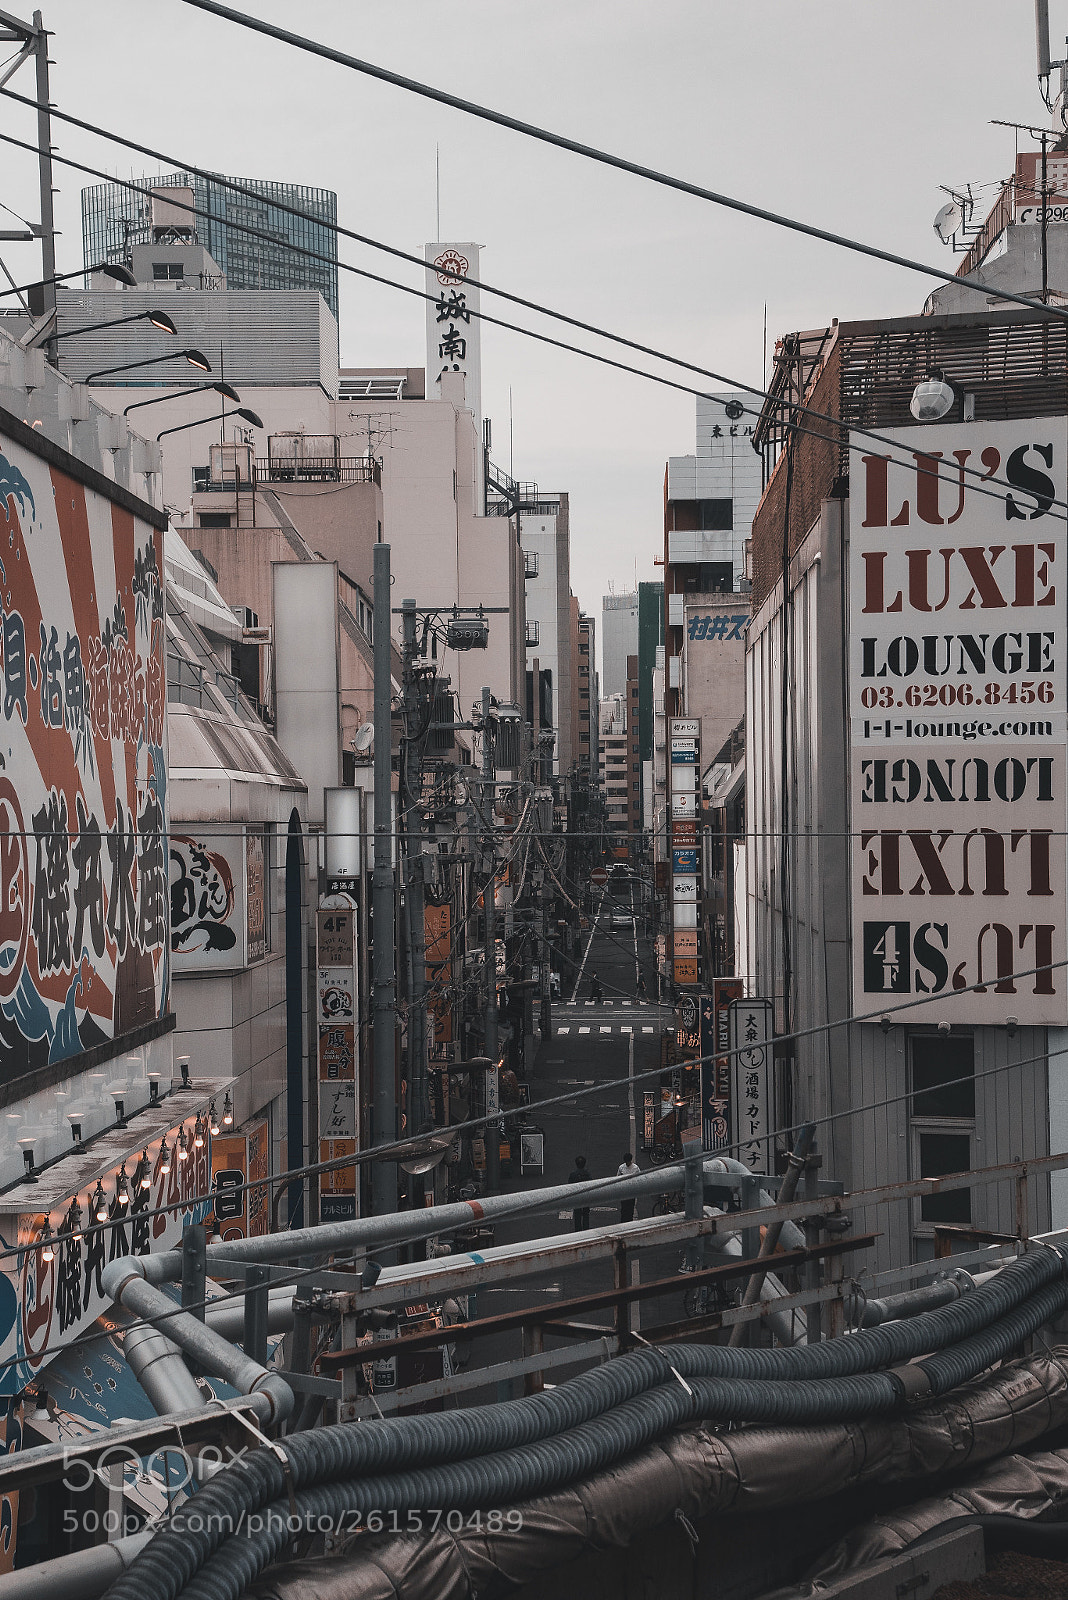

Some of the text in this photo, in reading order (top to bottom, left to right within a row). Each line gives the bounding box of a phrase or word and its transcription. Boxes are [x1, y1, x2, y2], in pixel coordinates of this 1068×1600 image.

[861, 443, 1056, 527] LU'S
[861, 543, 1056, 613] LUXE
[688, 615, 751, 640] 村井ス
[861, 632, 1055, 677] LOUNGE
[861, 681, 1055, 708] 03.6206.8456
[861, 758, 1054, 802] LOUNGE
[32, 788, 165, 972] 磯丸水産
[861, 828, 1054, 895] LUXE
[323, 917, 347, 932] 4F
[320, 971, 329, 979] 3F
[323, 1204, 354, 1215] ナルミビル
